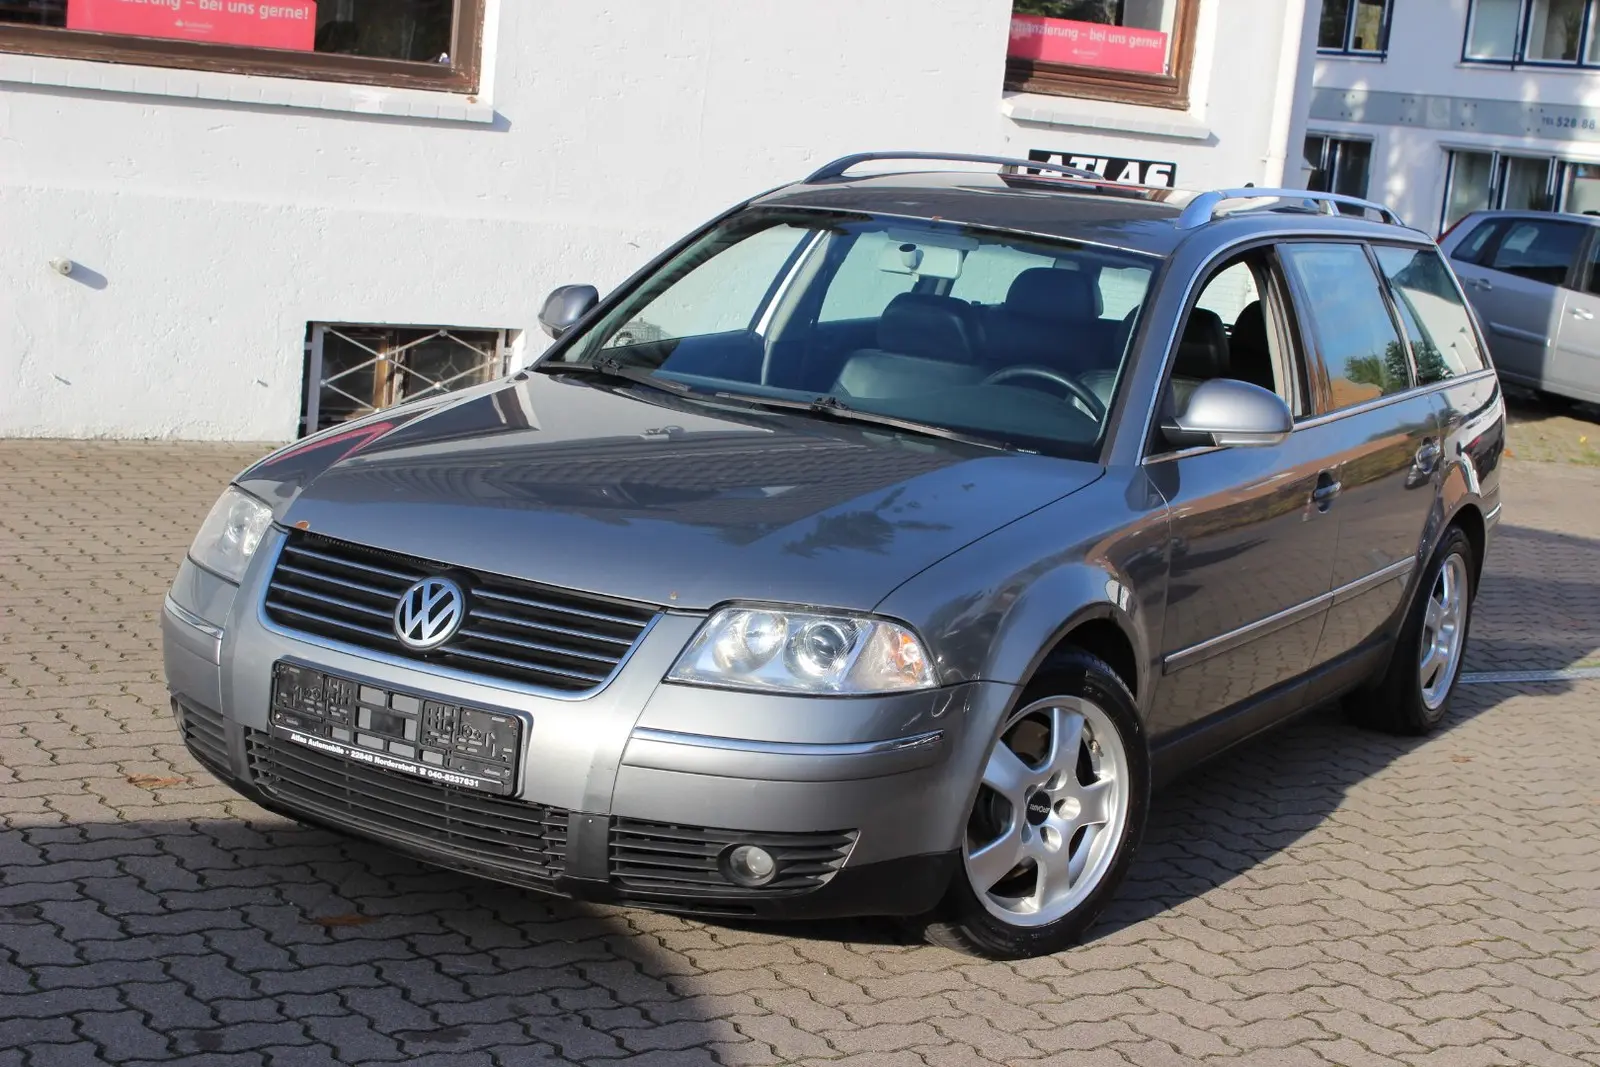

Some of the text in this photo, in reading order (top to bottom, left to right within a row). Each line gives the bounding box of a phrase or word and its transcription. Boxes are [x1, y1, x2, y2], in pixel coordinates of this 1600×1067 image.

[199, 0, 223, 11] bei
[227, 1, 255, 15] uns
[259, 4, 309, 20] gerne!
[1089, 28, 1106, 41] bei
[1108, 33, 1126, 44] uns
[1129, 36, 1162, 48] gerne!
[291, 733, 307, 744] Atlas
[308, 738, 345, 754] Automobile
[374, 756, 417, 773] Norderstedt
